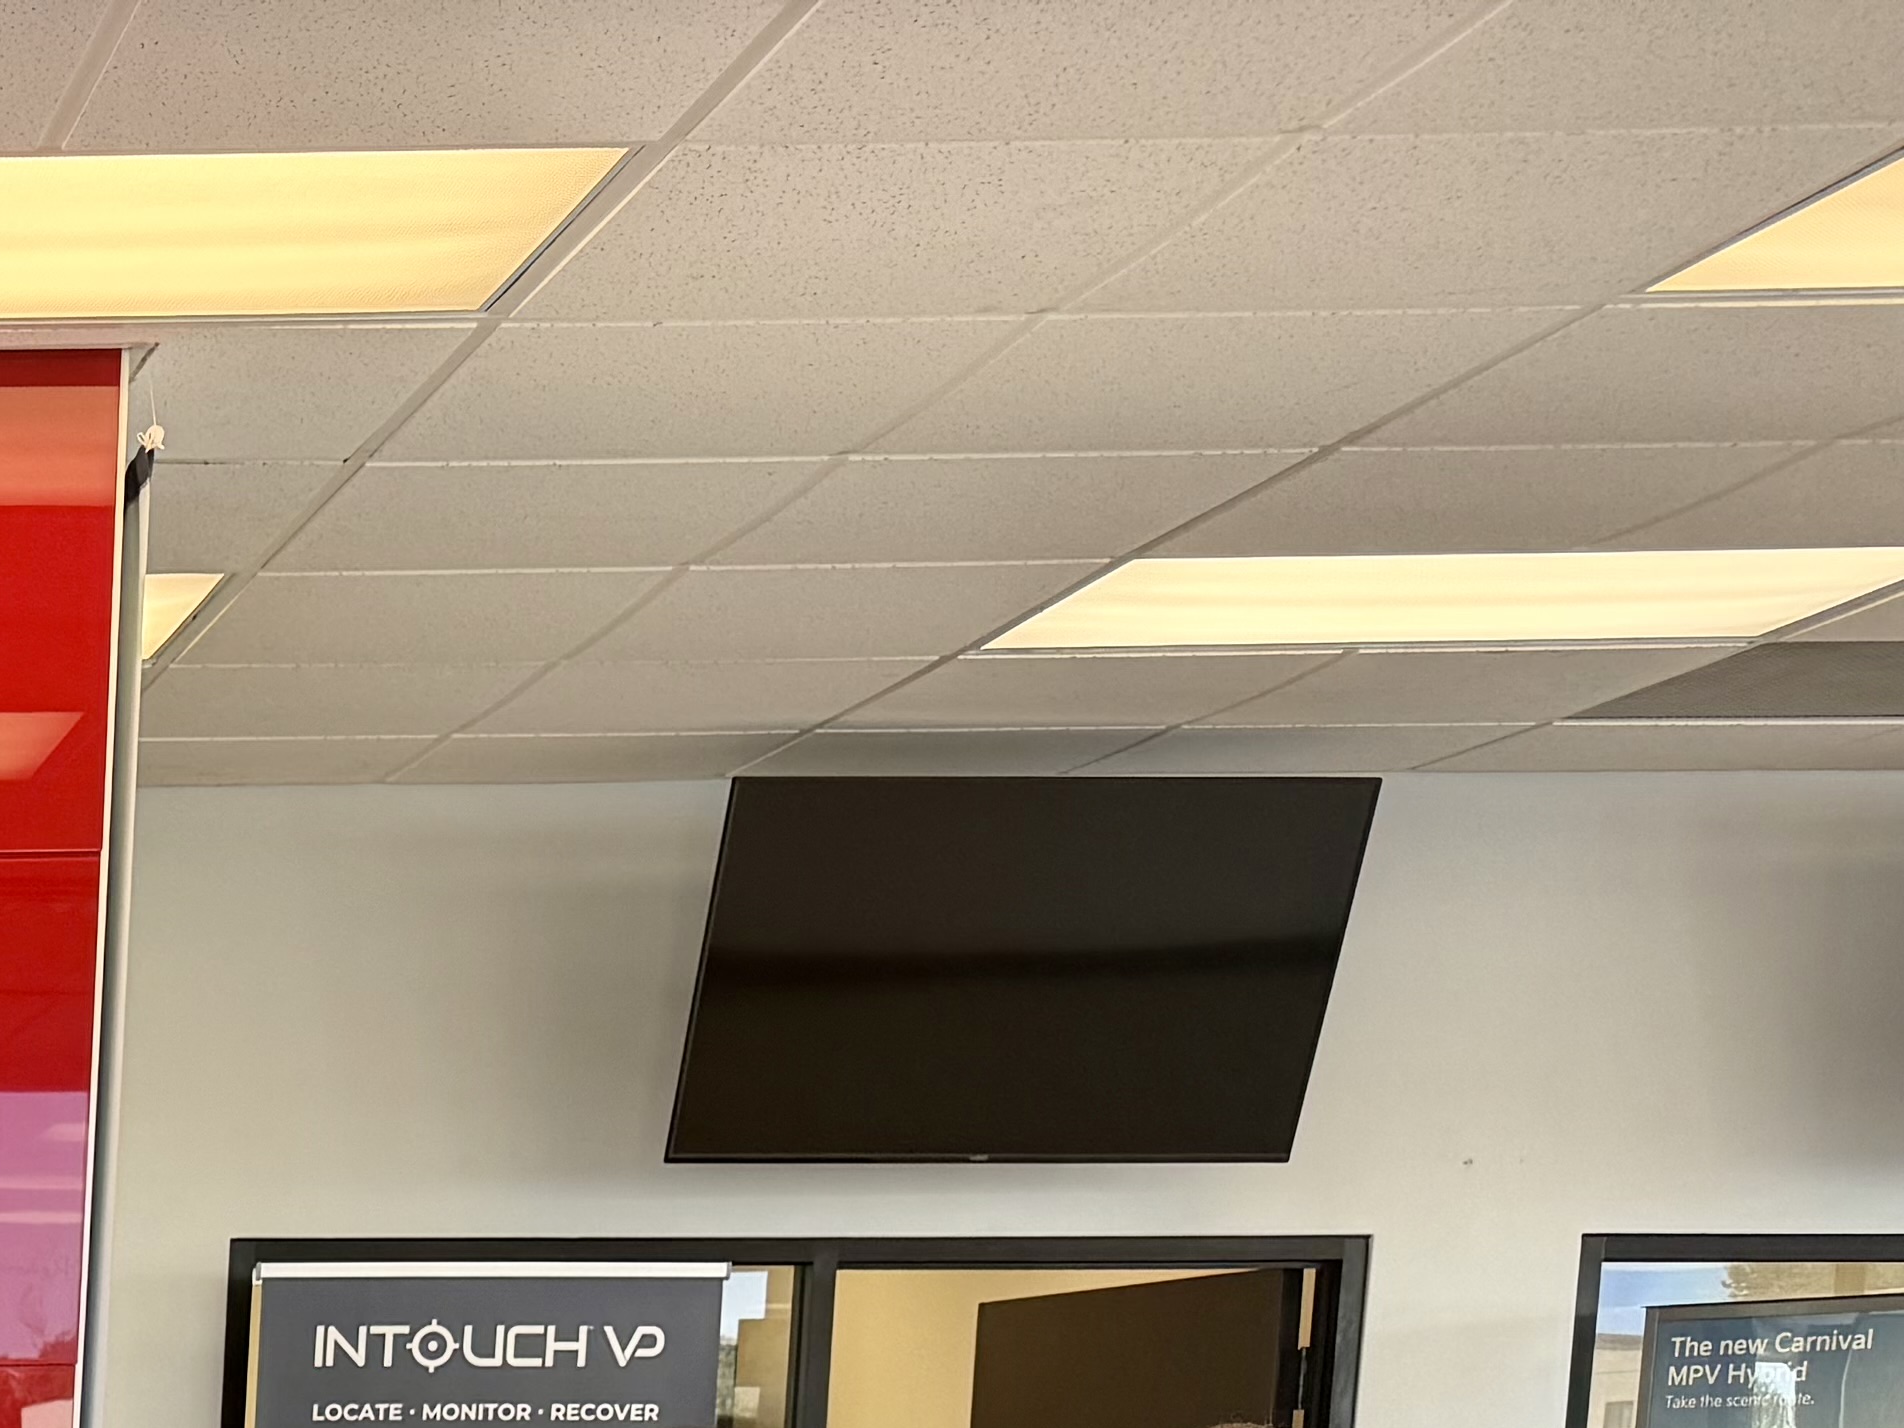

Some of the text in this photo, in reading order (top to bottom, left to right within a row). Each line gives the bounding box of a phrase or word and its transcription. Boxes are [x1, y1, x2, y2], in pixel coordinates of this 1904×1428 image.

[313, 1319, 665, 1372] INTOUCH VP
[1671, 1329, 1874, 1358] The new Carnival
[1667, 1364, 1721, 1387] MPV
[312, 1403, 659, 1422] LOCATE MONITOR RECOVER
[1665, 1395, 1696, 1409] Take
[1700, 1394, 1722, 1407] the
